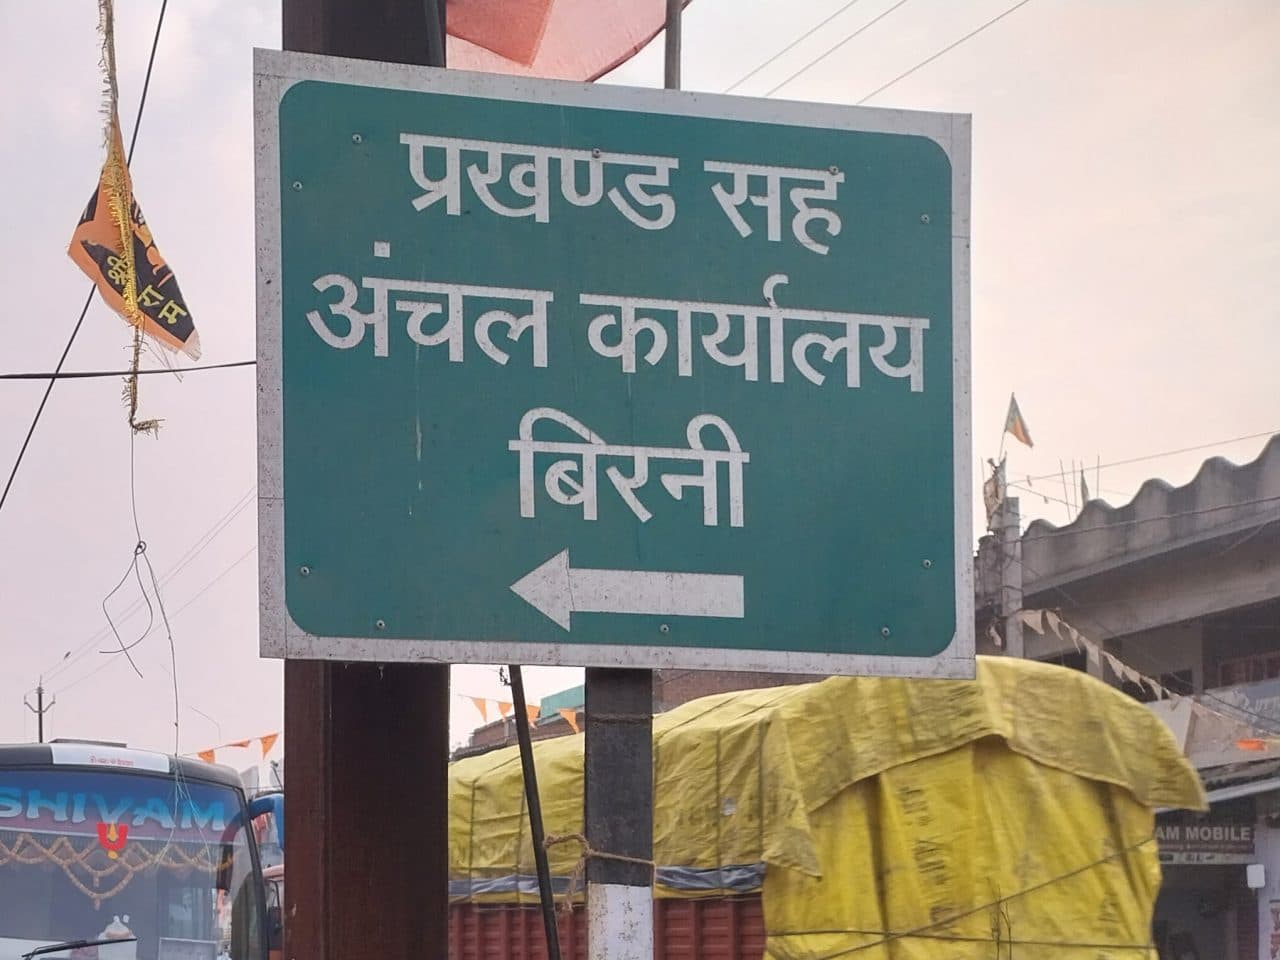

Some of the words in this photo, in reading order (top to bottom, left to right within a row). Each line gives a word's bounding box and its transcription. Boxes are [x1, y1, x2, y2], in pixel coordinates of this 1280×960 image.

[400, 132, 679, 231] प्रखण्ड
[704, 160, 845, 255] सह
[306, 241, 554, 368] अंचल
[580, 273, 930, 392] कार्यालय
[508, 407, 750, 527] बिरनी
[1155, 827, 1179, 840] AM
[1185, 827, 1251, 840] MOBILE
